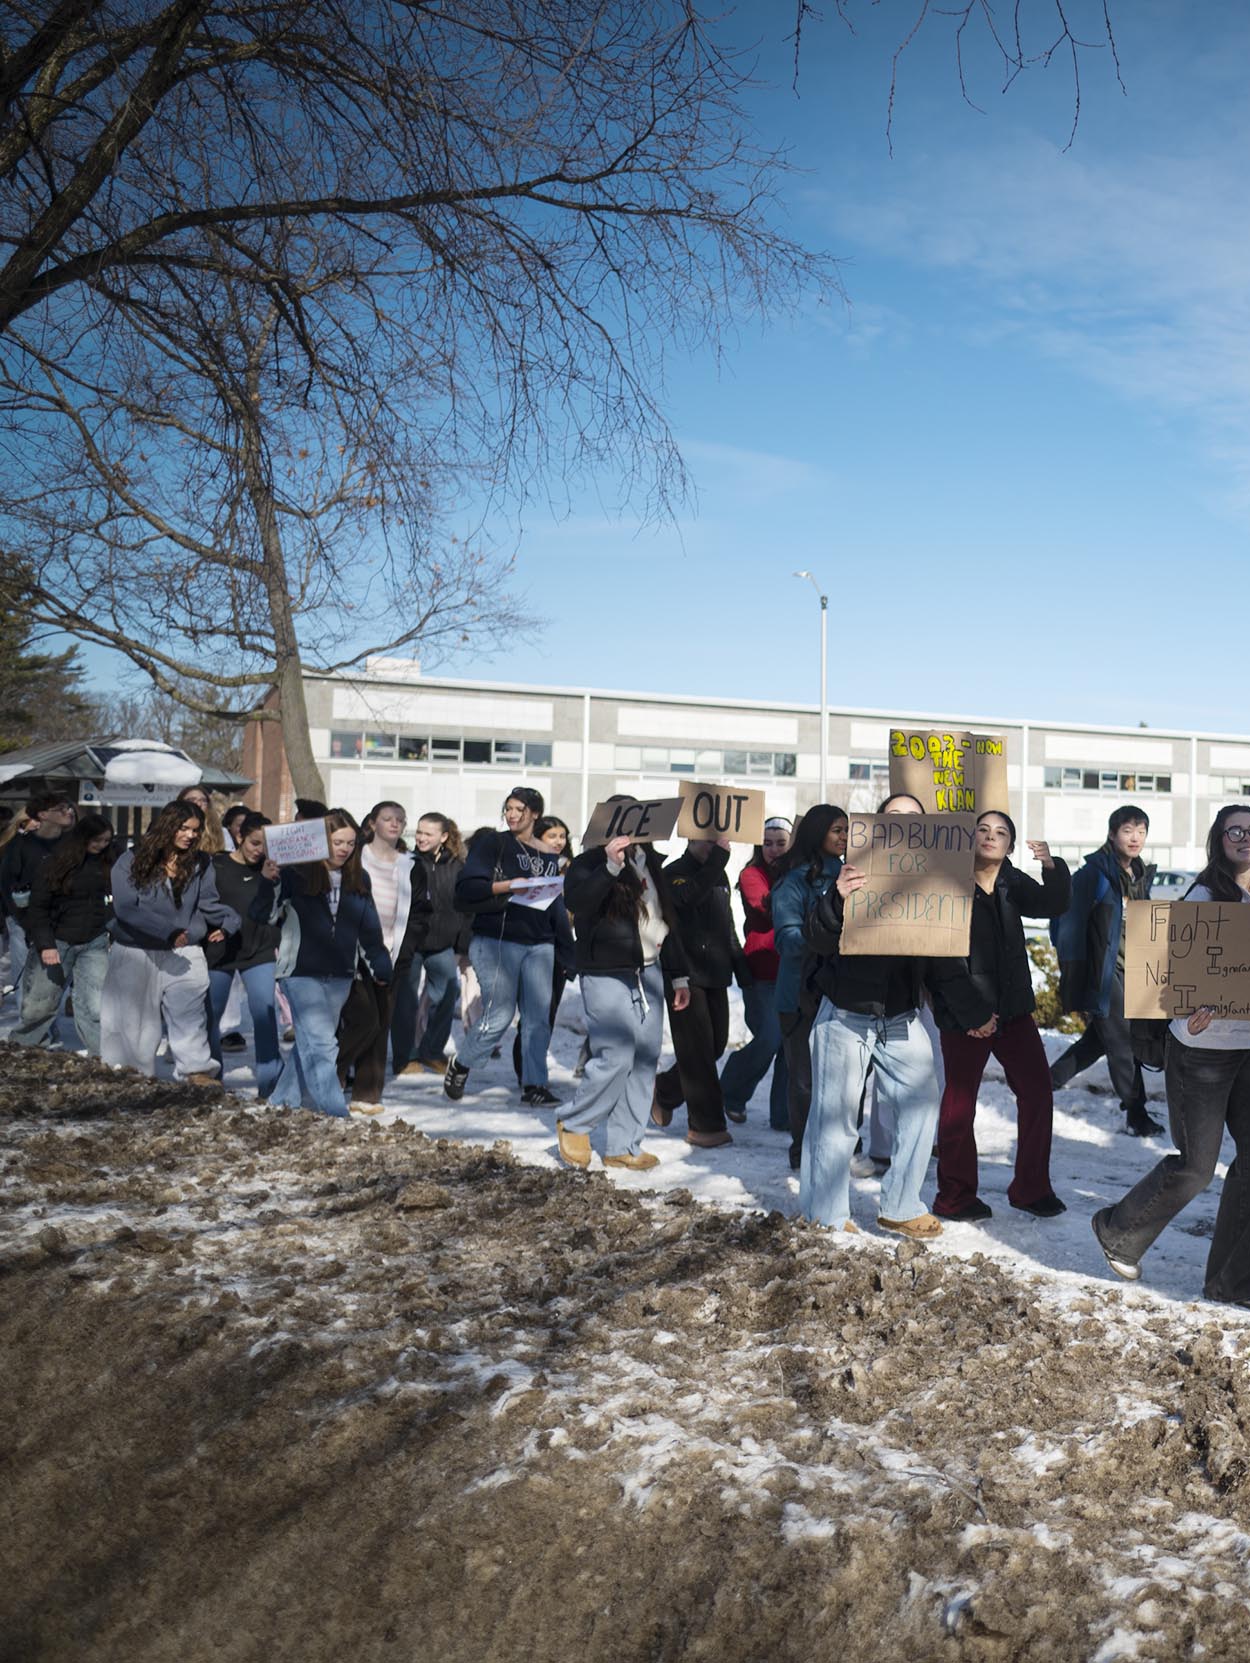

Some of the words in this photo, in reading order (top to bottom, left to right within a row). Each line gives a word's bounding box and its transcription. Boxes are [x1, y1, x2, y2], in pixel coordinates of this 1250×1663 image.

[890, 730, 956, 761] 2003
[975, 738, 1003, 756] NOW
[930, 750, 965, 771] THE
[932, 769, 965, 787] NEW
[692, 791, 749, 832] OUT
[935, 788, 976, 812] KLAN
[605, 803, 662, 838] ICE
[850, 821, 904, 849] BAD
[516, 854, 558, 878] USA
[888, 853, 928, 873] FOR
[1150, 903, 1230, 959] Fight
[1145, 959, 1175, 986] Not
